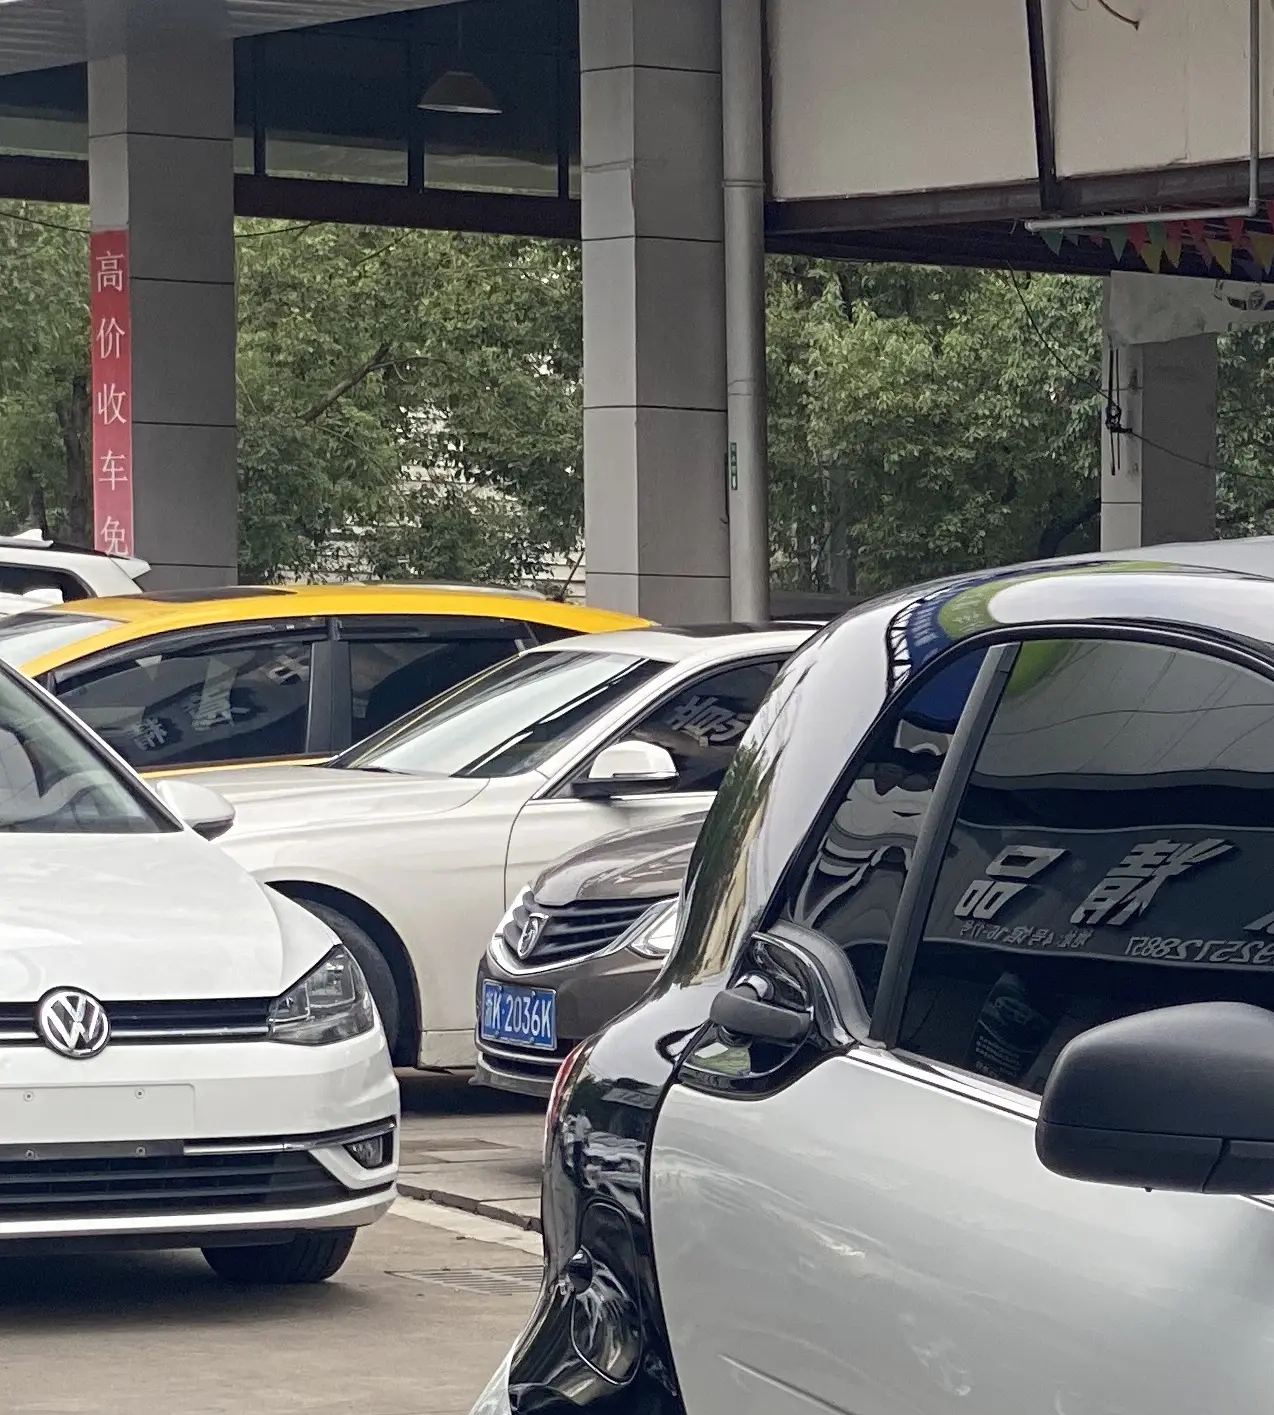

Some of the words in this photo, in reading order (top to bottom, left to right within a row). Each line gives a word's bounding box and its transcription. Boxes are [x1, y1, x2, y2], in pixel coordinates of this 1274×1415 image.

[95, 250, 130, 556] 高价收车免
